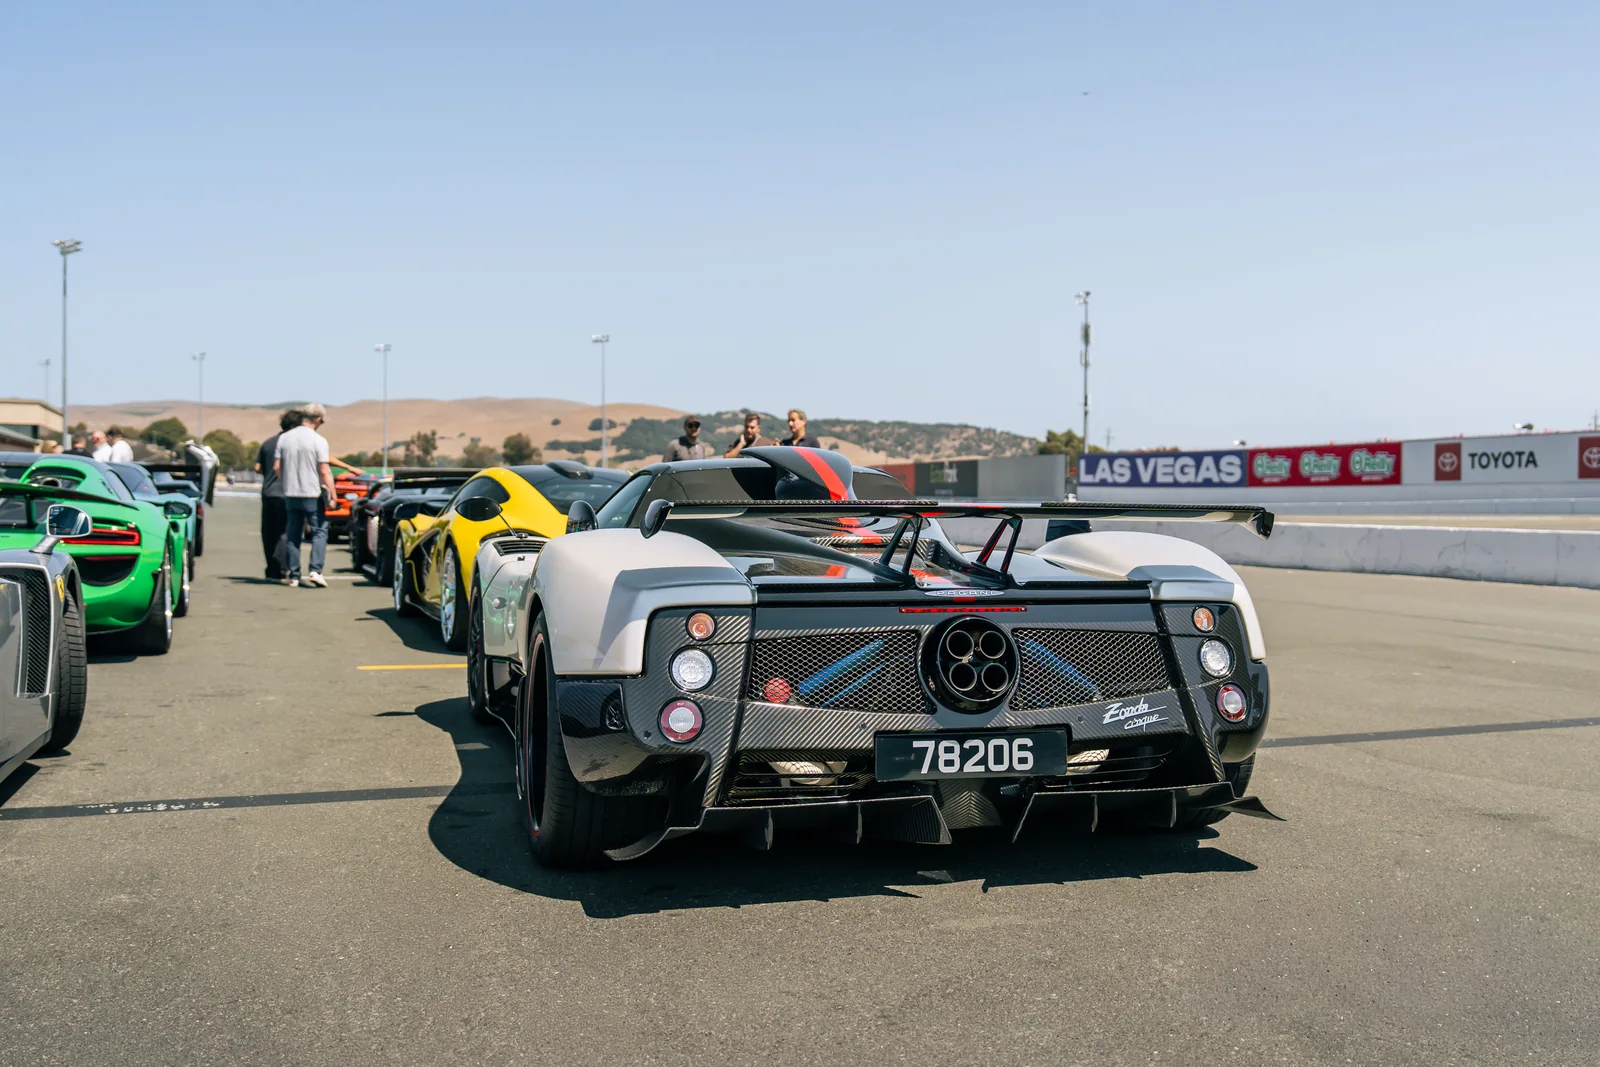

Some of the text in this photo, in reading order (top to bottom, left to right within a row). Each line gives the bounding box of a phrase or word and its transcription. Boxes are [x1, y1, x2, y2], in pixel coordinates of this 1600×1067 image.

[1079, 454, 1243, 484] LAS VEGAS
[1468, 451, 1538, 470] TOYOTA
[1103, 697, 1167, 724] Zonda
[912, 738, 1034, 775] 78206
